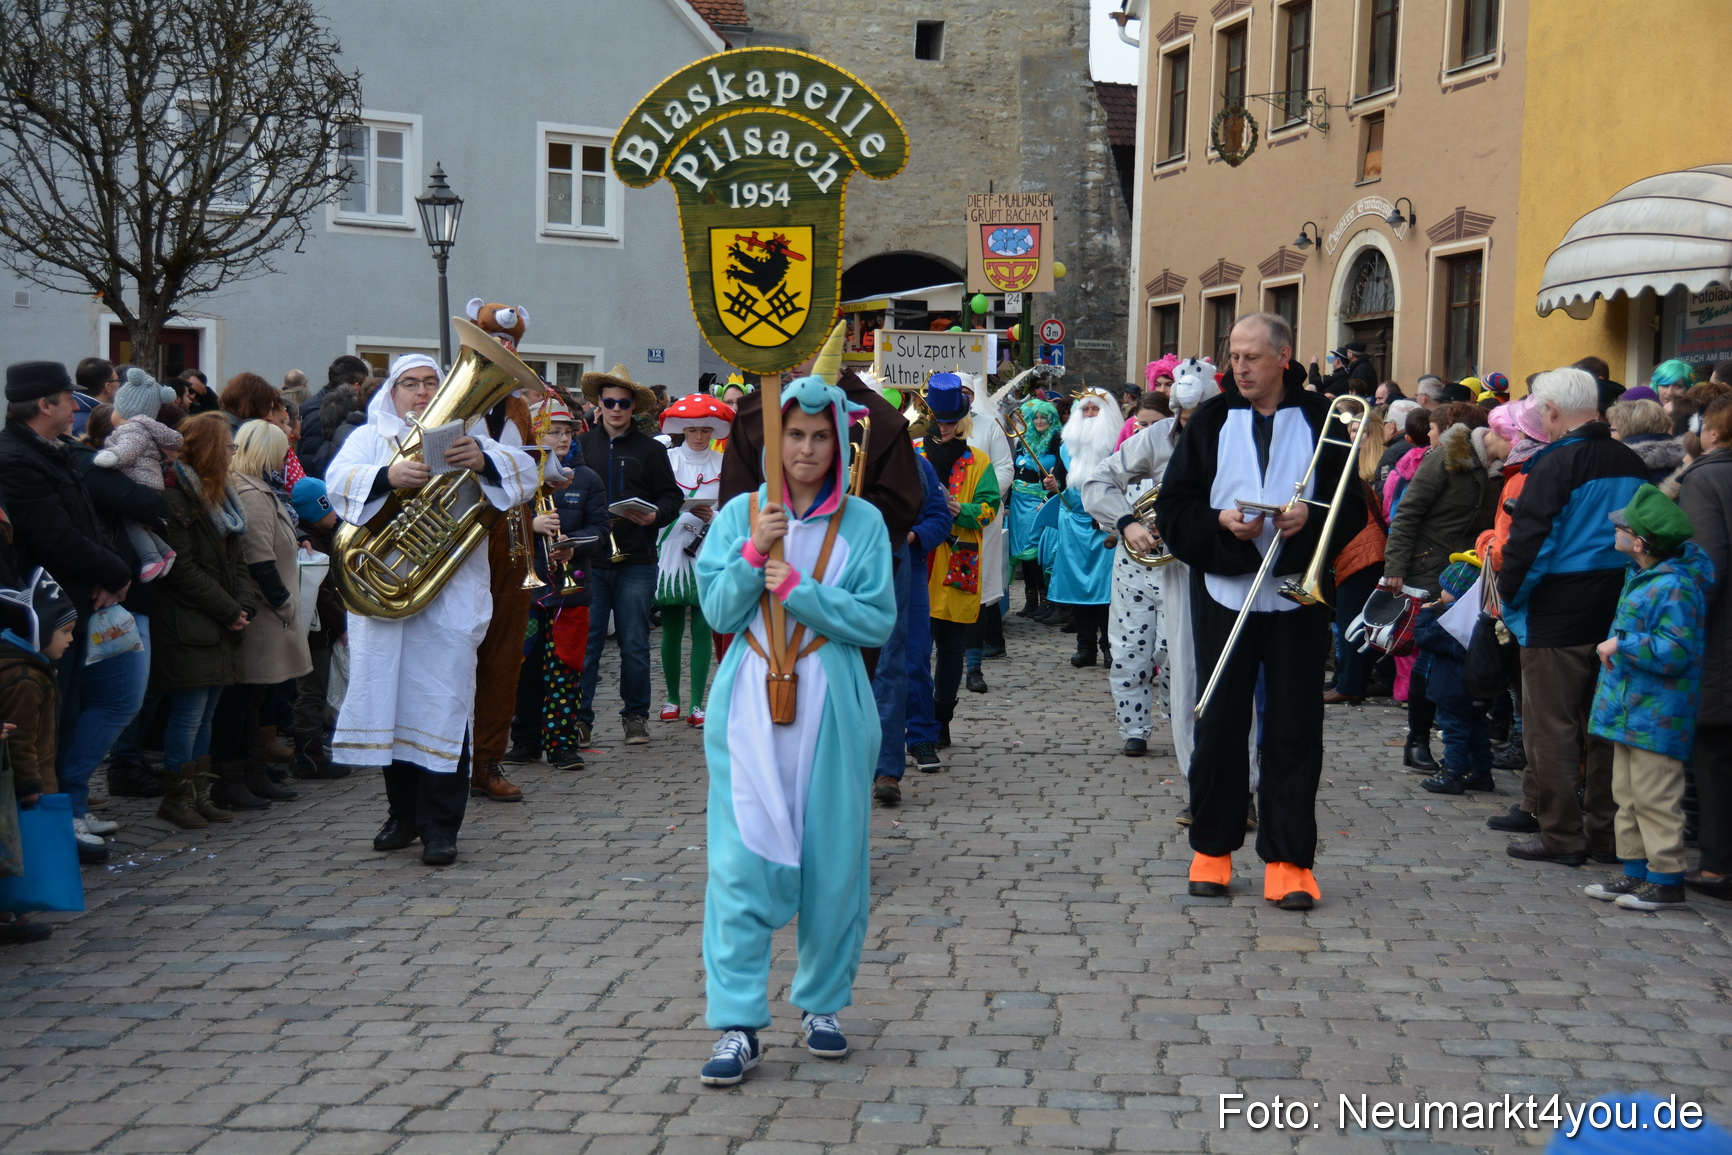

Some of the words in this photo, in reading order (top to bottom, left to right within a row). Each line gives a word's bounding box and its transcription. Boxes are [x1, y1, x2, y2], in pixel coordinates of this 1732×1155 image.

[617, 65, 886, 176] Blaskapelle
[671, 126, 840, 194] Pilsach
[729, 182, 791, 209] 1954
[1005, 208, 1048, 223] BACHAM
[1007, 293, 1020, 305] 24
[651, 349, 661, 357] 12
[896, 335, 966, 362] Sulzpark
[1705, 352, 1717, 362] AM
[1719, 351, 1732, 361] BIL
[317, 495, 331, 511] 5
